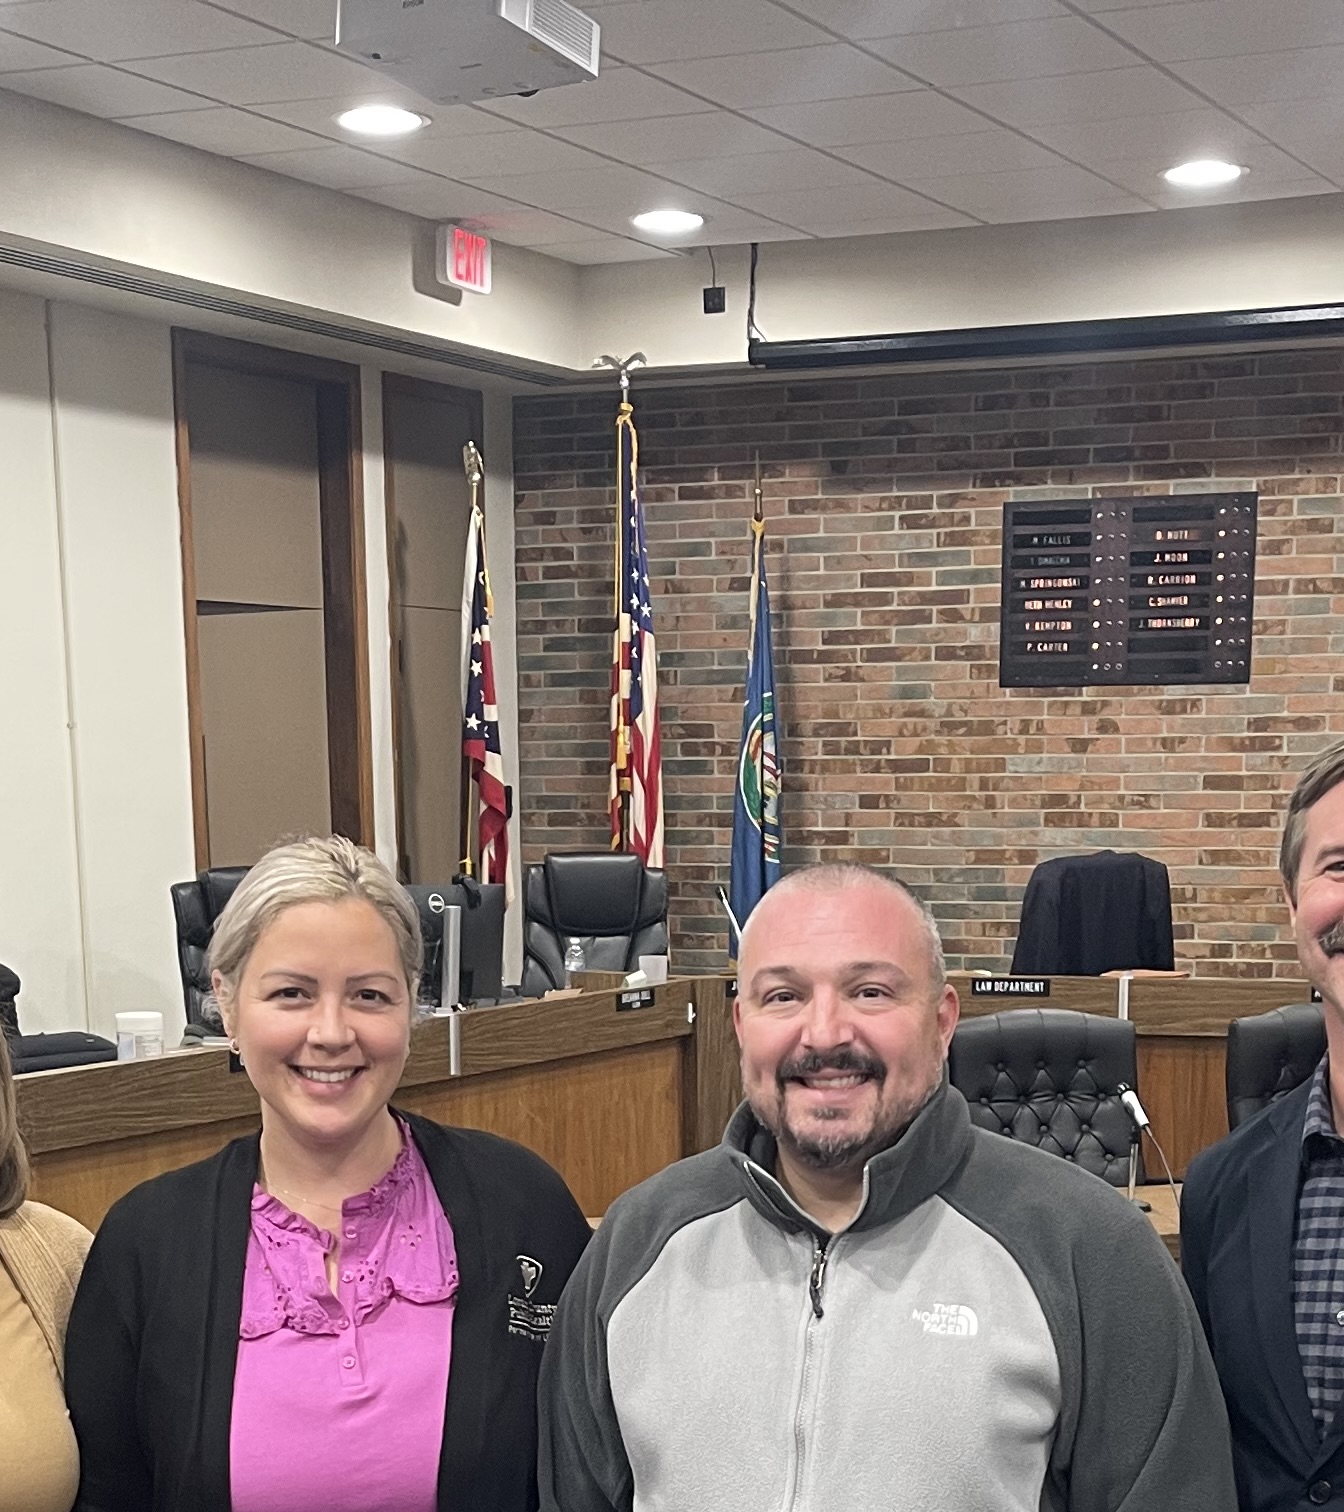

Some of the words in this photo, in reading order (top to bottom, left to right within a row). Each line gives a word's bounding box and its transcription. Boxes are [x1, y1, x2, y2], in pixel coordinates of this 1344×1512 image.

[455, 229, 487, 287] EXIT
[1037, 642, 1069, 653] CARTER
[975, 981, 993, 992] LAW
[994, 981, 1045, 993] DEPARTMENT
[933, 1303, 960, 1315] THE
[912, 1308, 958, 1326] NORTH
[923, 1321, 956, 1336] FACE
